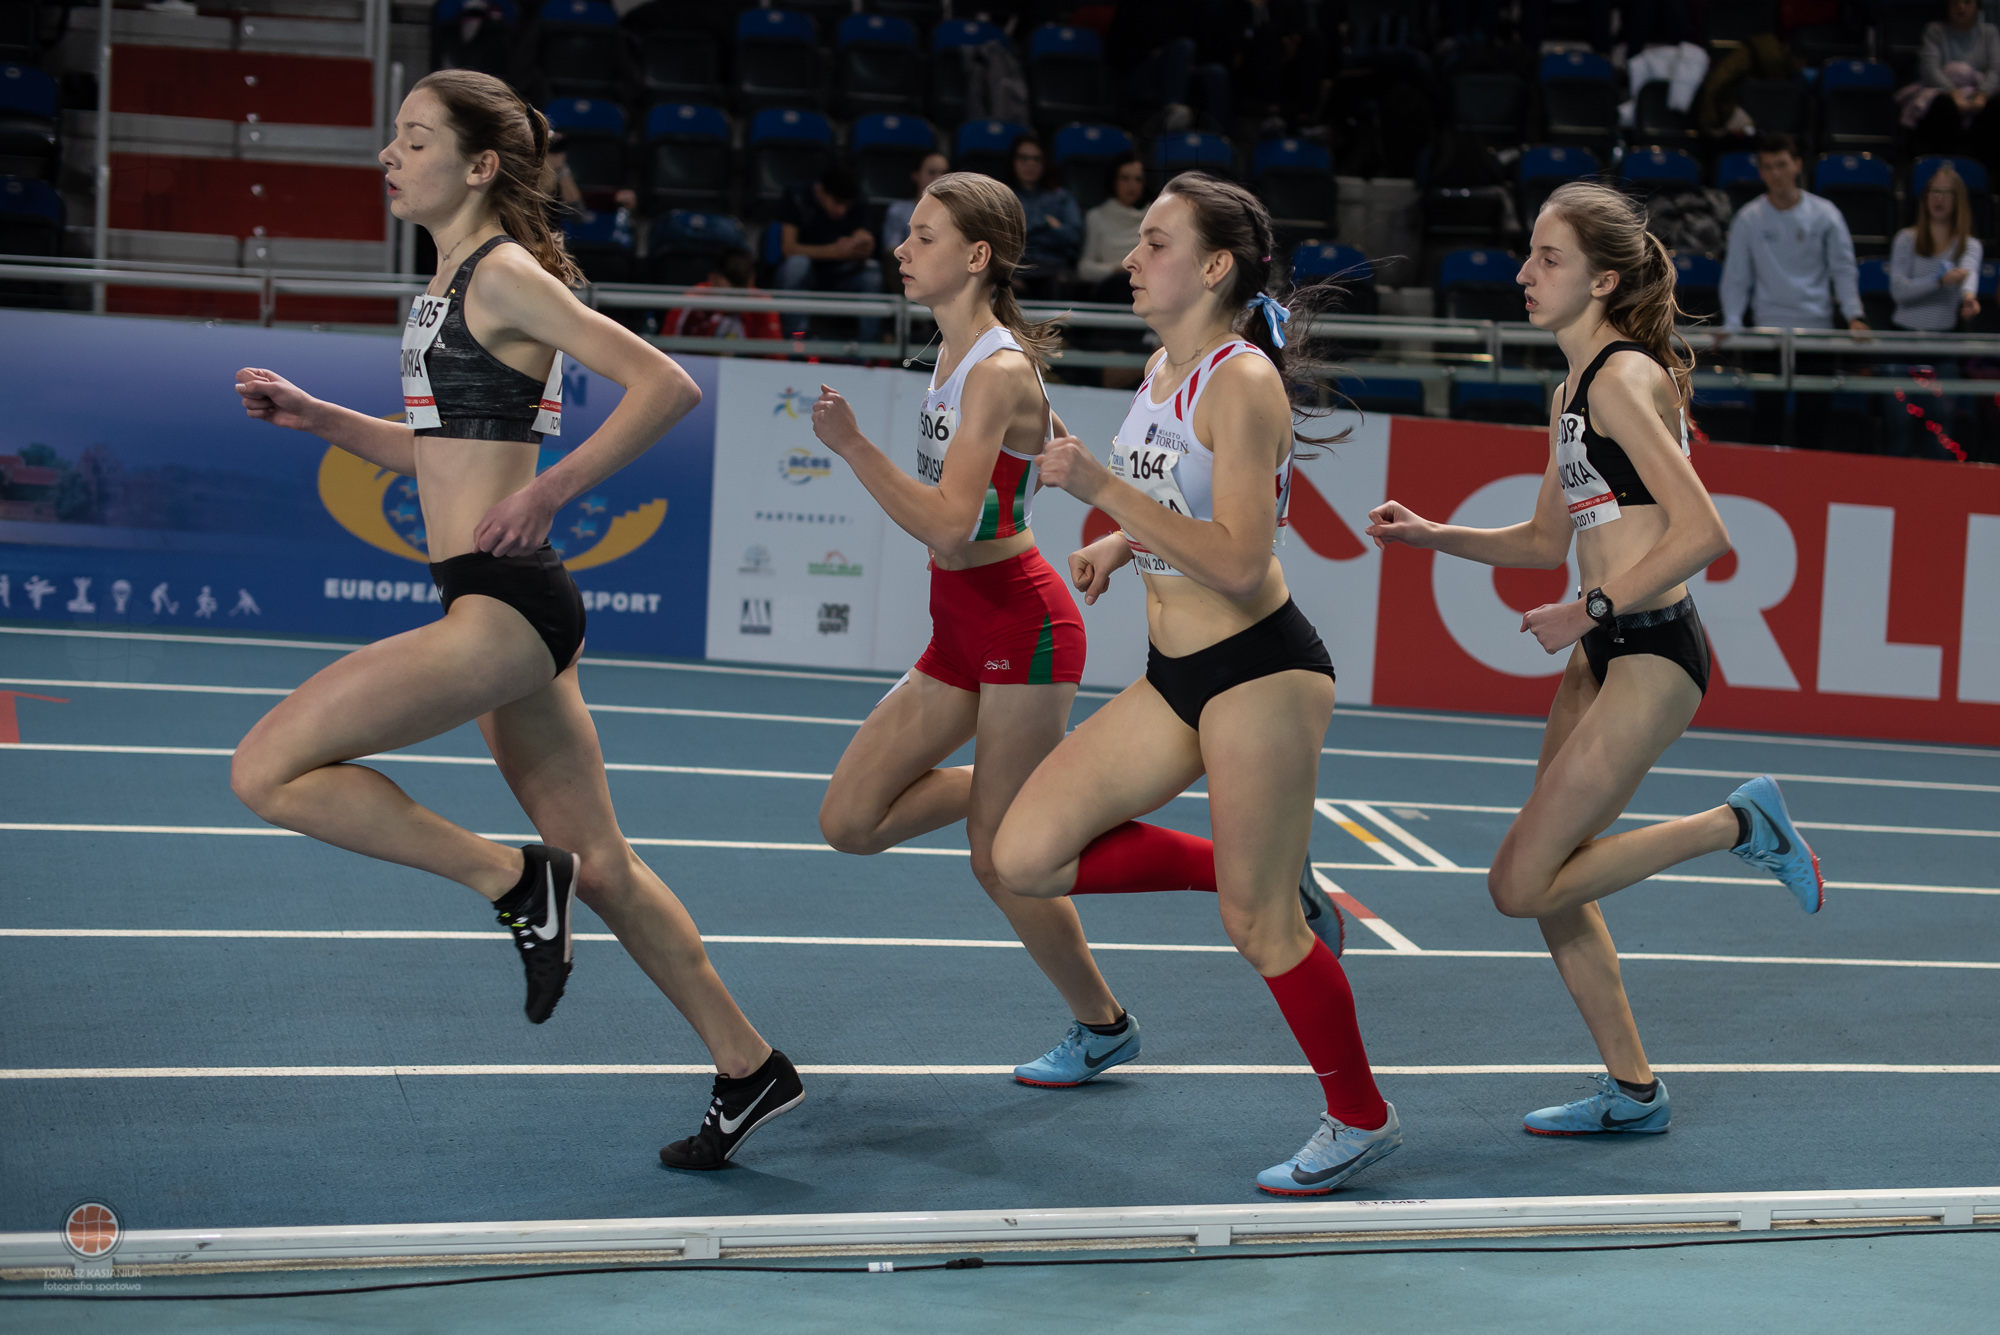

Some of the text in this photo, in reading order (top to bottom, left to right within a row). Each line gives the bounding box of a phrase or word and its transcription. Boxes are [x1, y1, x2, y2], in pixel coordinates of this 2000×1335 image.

[417, 299, 445, 328] 05
[920, 411, 950, 442] 506
[1158, 429, 1181, 440] MIASTO
[1155, 434, 1189, 453] TORUŃ
[1129, 450, 1167, 479] 164
[1576, 510, 1596, 528] 2019
[1431, 472, 2000, 705] ORL
[580, 590, 661, 614] SPORT
